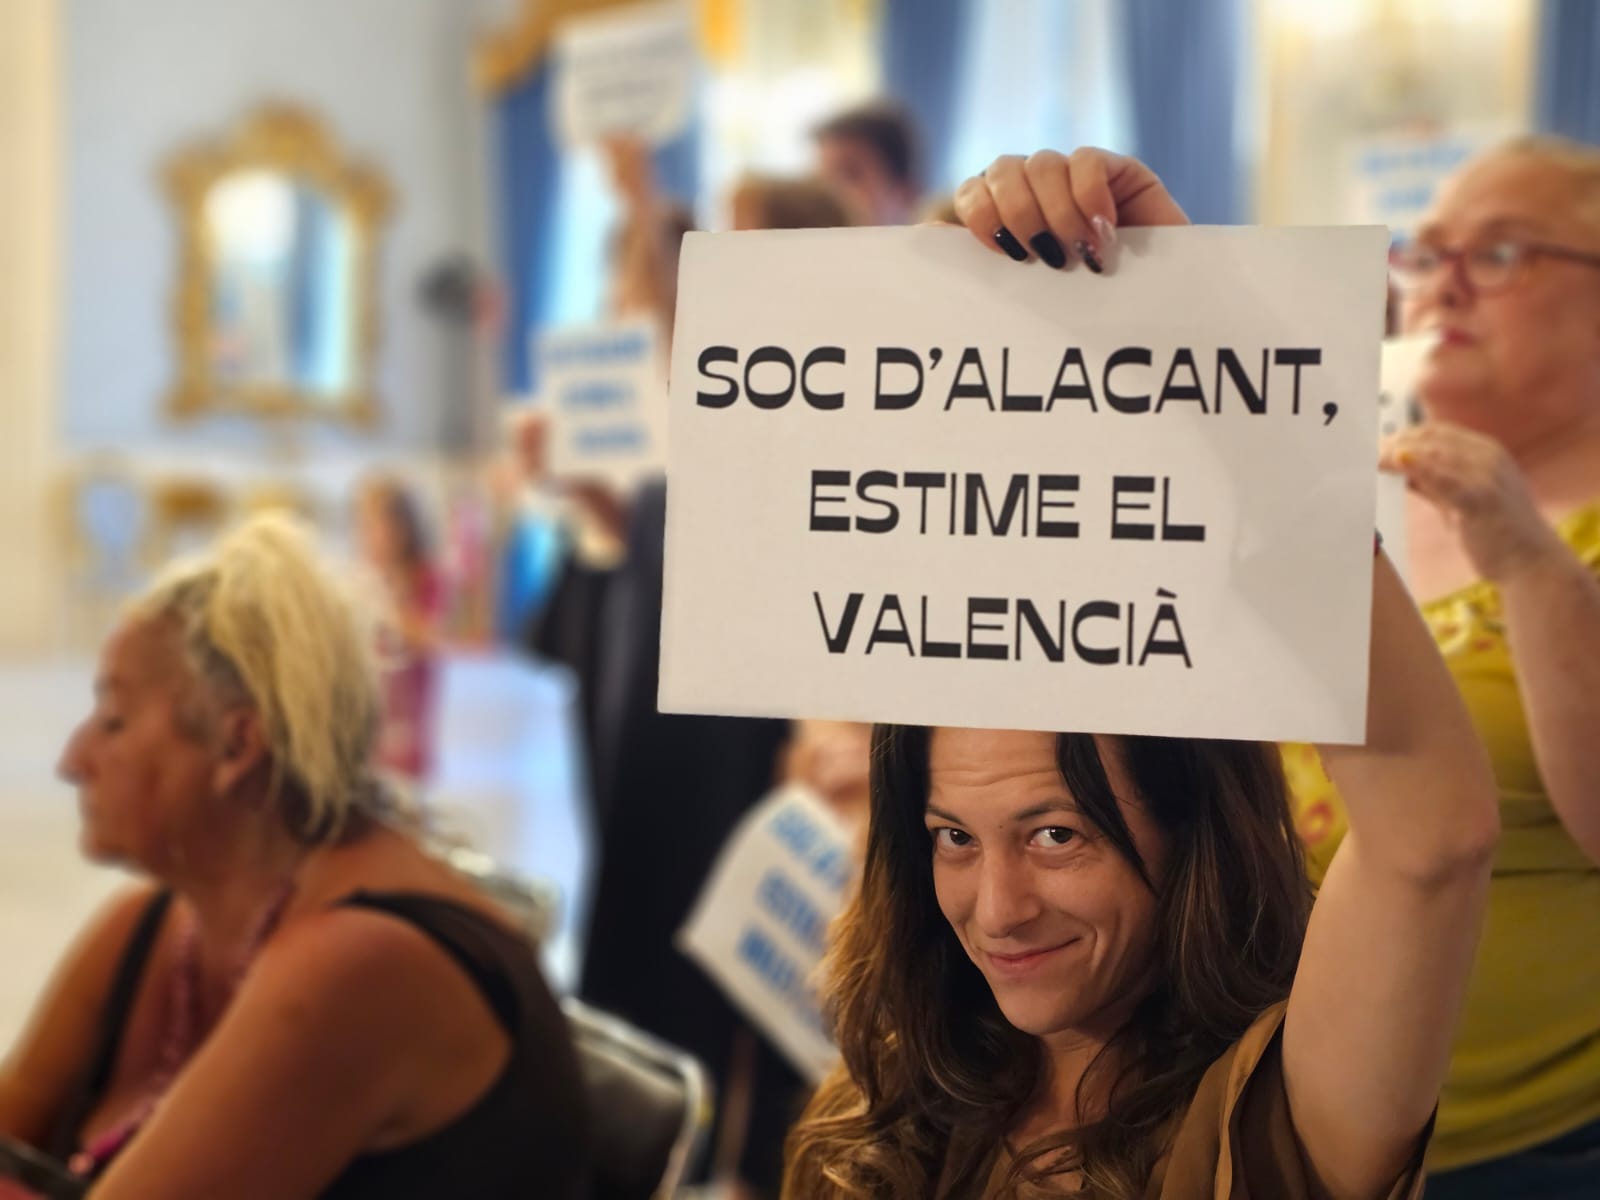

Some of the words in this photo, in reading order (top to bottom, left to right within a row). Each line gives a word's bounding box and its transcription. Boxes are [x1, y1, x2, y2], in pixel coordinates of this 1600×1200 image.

[696, 345, 846, 411] SOC
[874, 346, 1339, 425] D'ALACANT,
[809, 470, 1080, 539] ESTIME
[1111, 475, 1206, 542] EL
[813, 587, 1193, 668] VALENCIÀ
